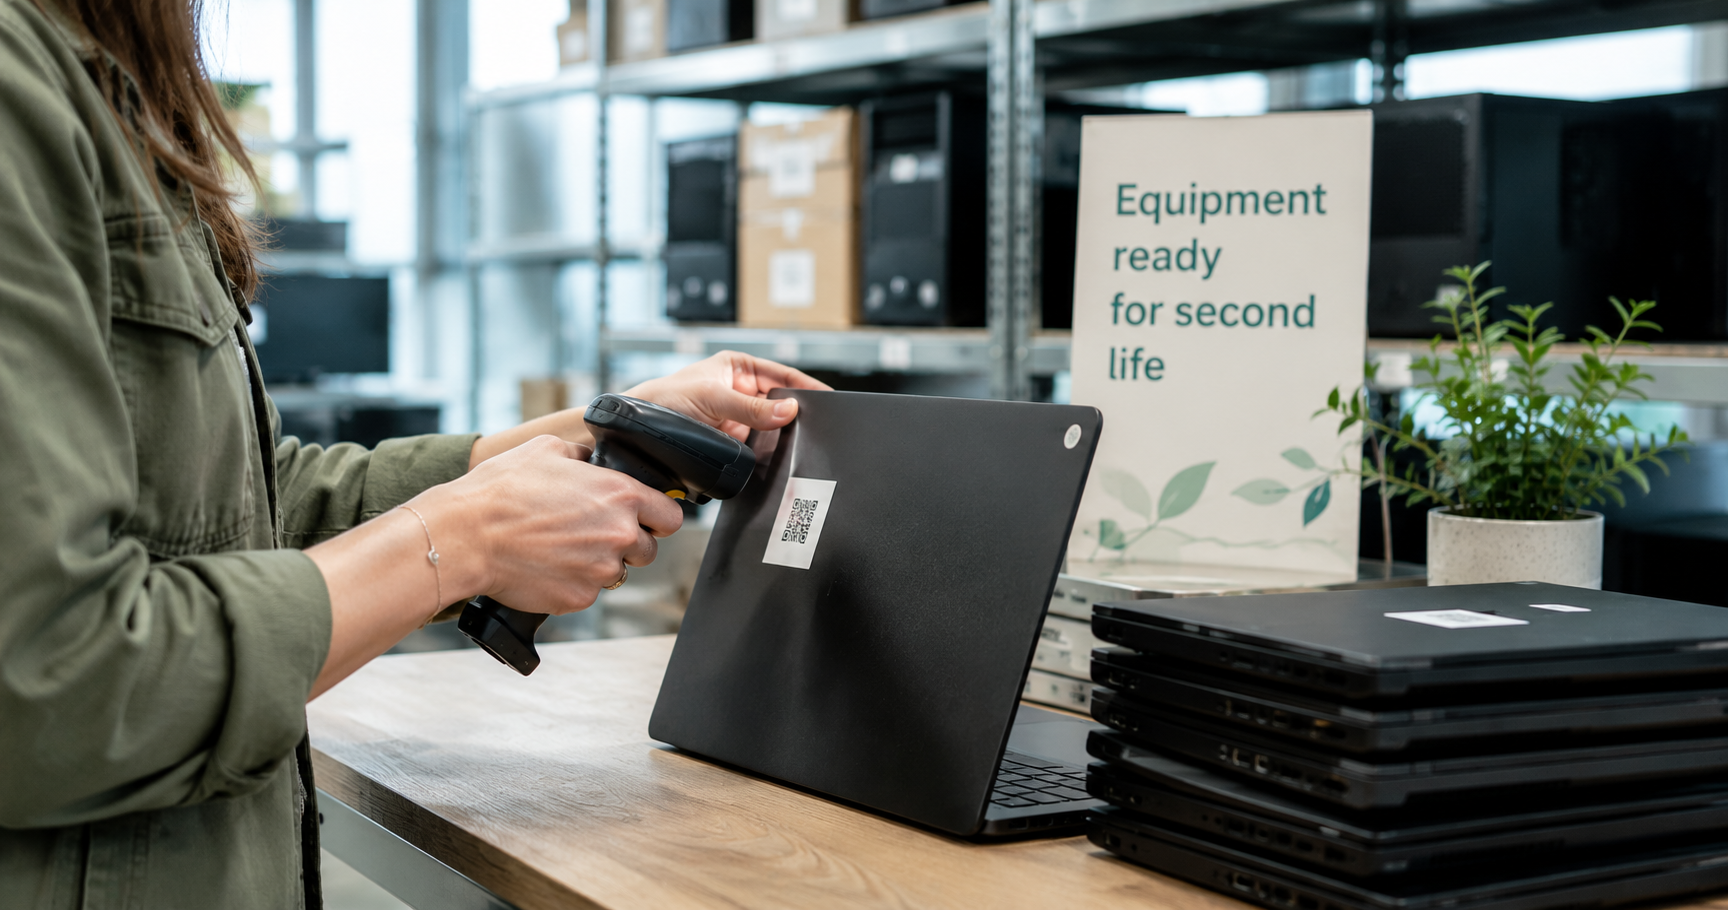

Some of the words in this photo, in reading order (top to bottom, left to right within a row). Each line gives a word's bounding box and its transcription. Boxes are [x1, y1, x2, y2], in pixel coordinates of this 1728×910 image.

[1116, 183, 1327, 225] Equipment
[1113, 238, 1222, 280] ready
[1111, 292, 1164, 326] for
[1175, 294, 1315, 328] second
[1109, 347, 1166, 381] life
